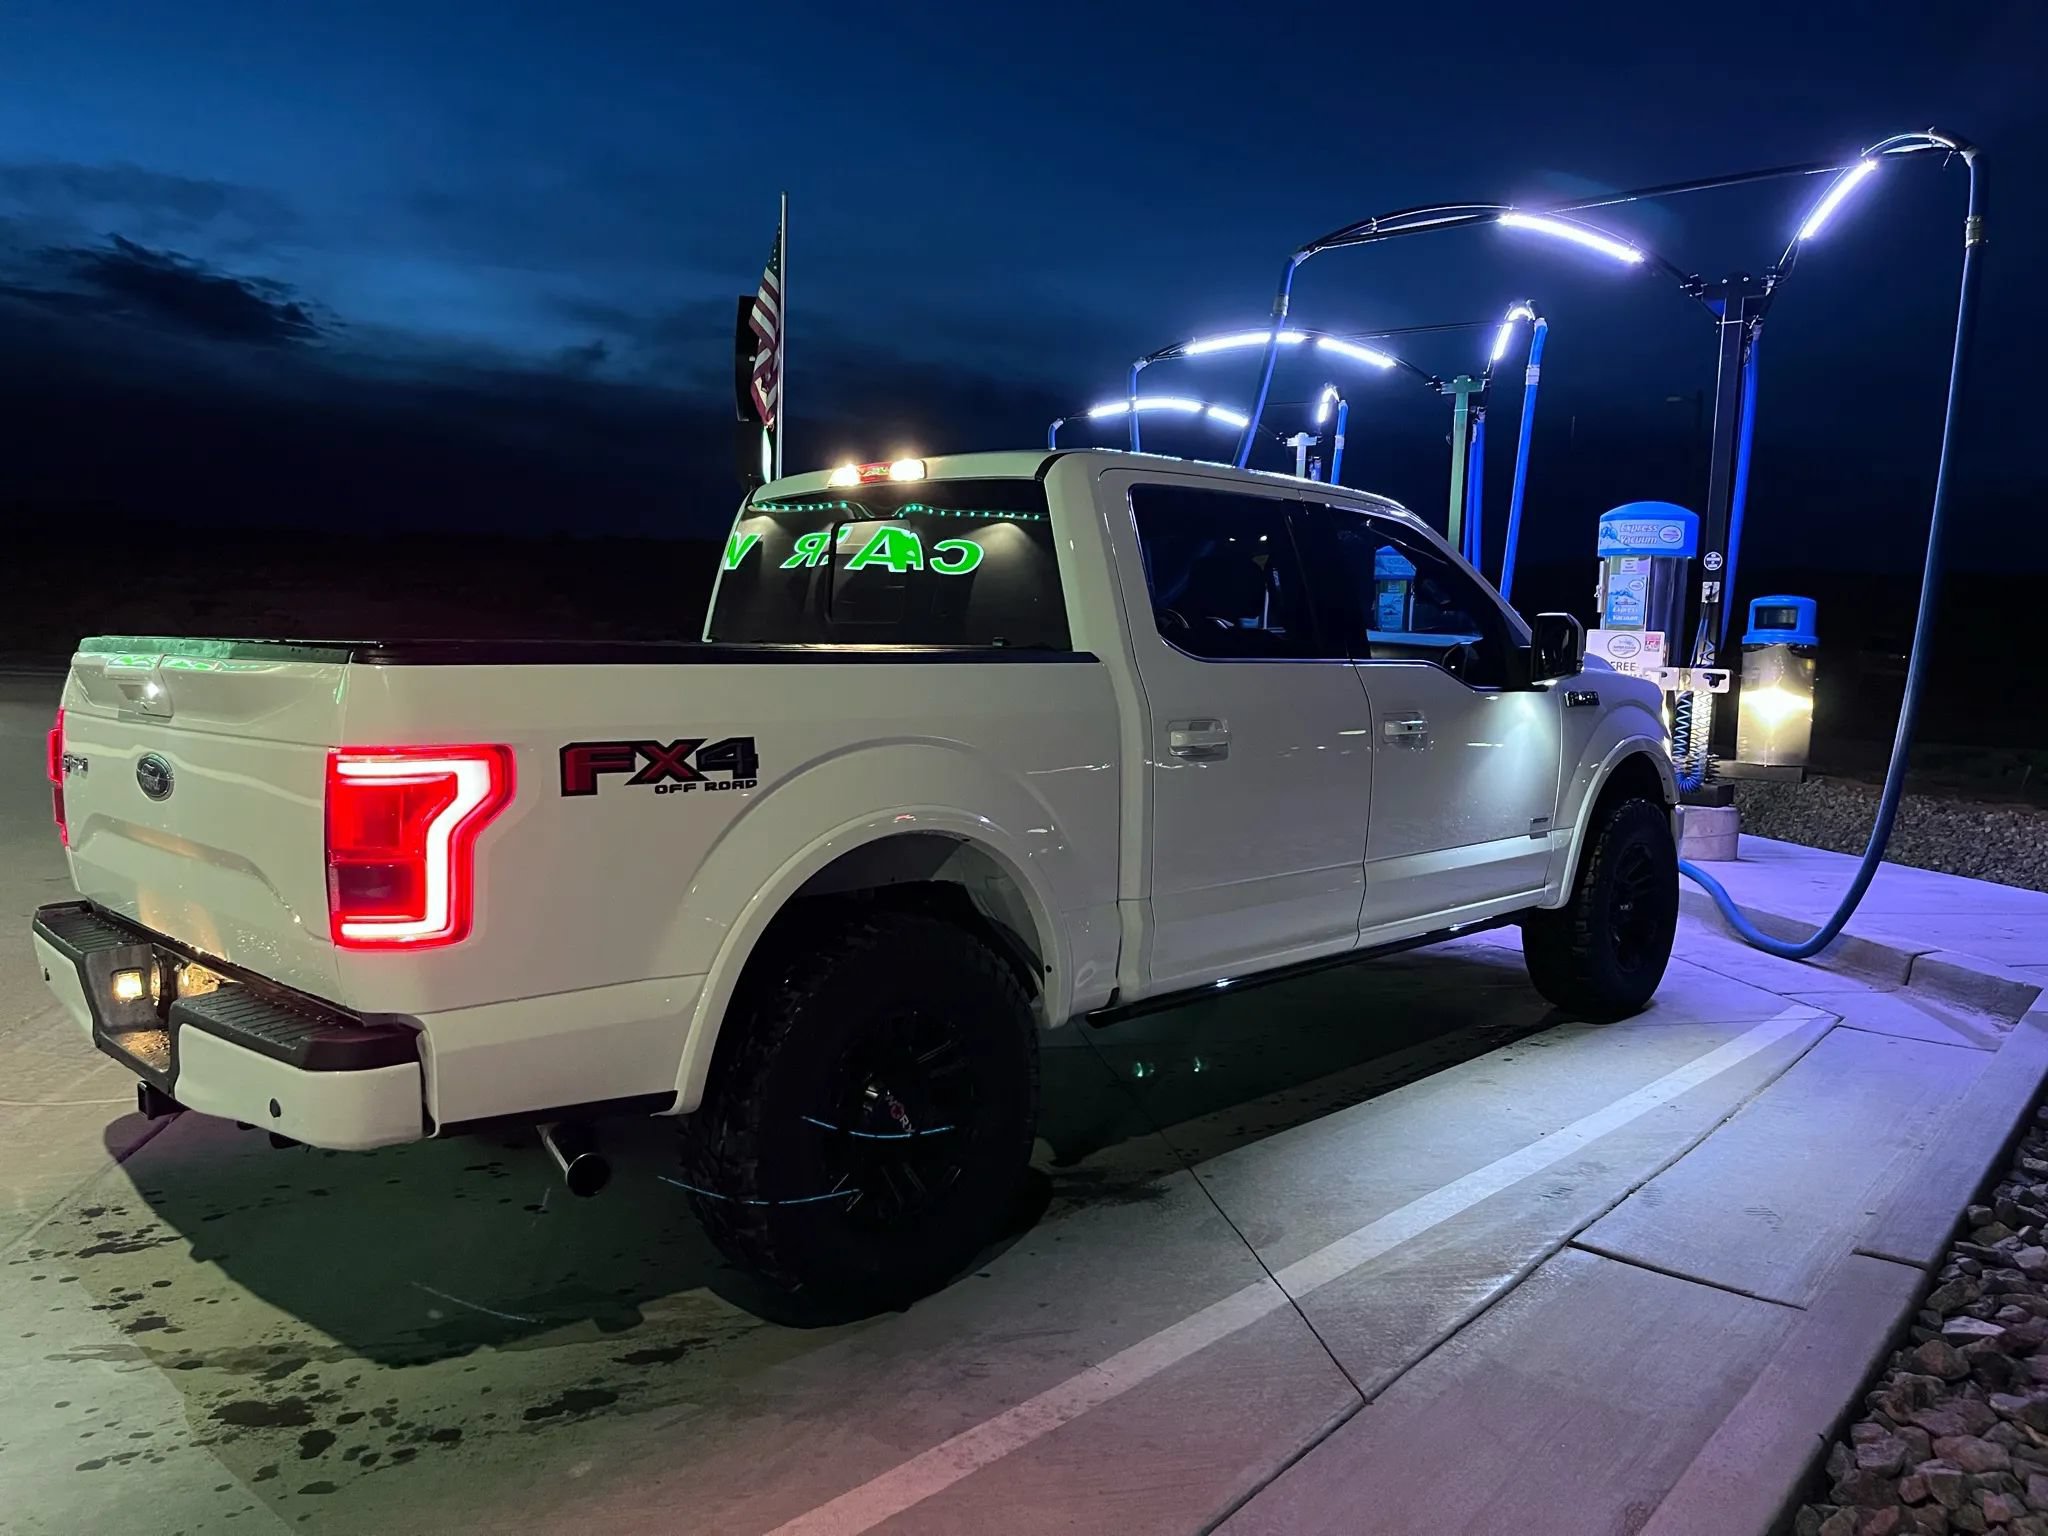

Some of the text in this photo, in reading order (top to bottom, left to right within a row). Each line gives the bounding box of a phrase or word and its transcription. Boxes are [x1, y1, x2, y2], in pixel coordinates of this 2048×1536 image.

[1619, 534, 1658, 545] Vacuum
[559, 736, 759, 797] FX4
[654, 780, 758, 795] OFF ROAD
